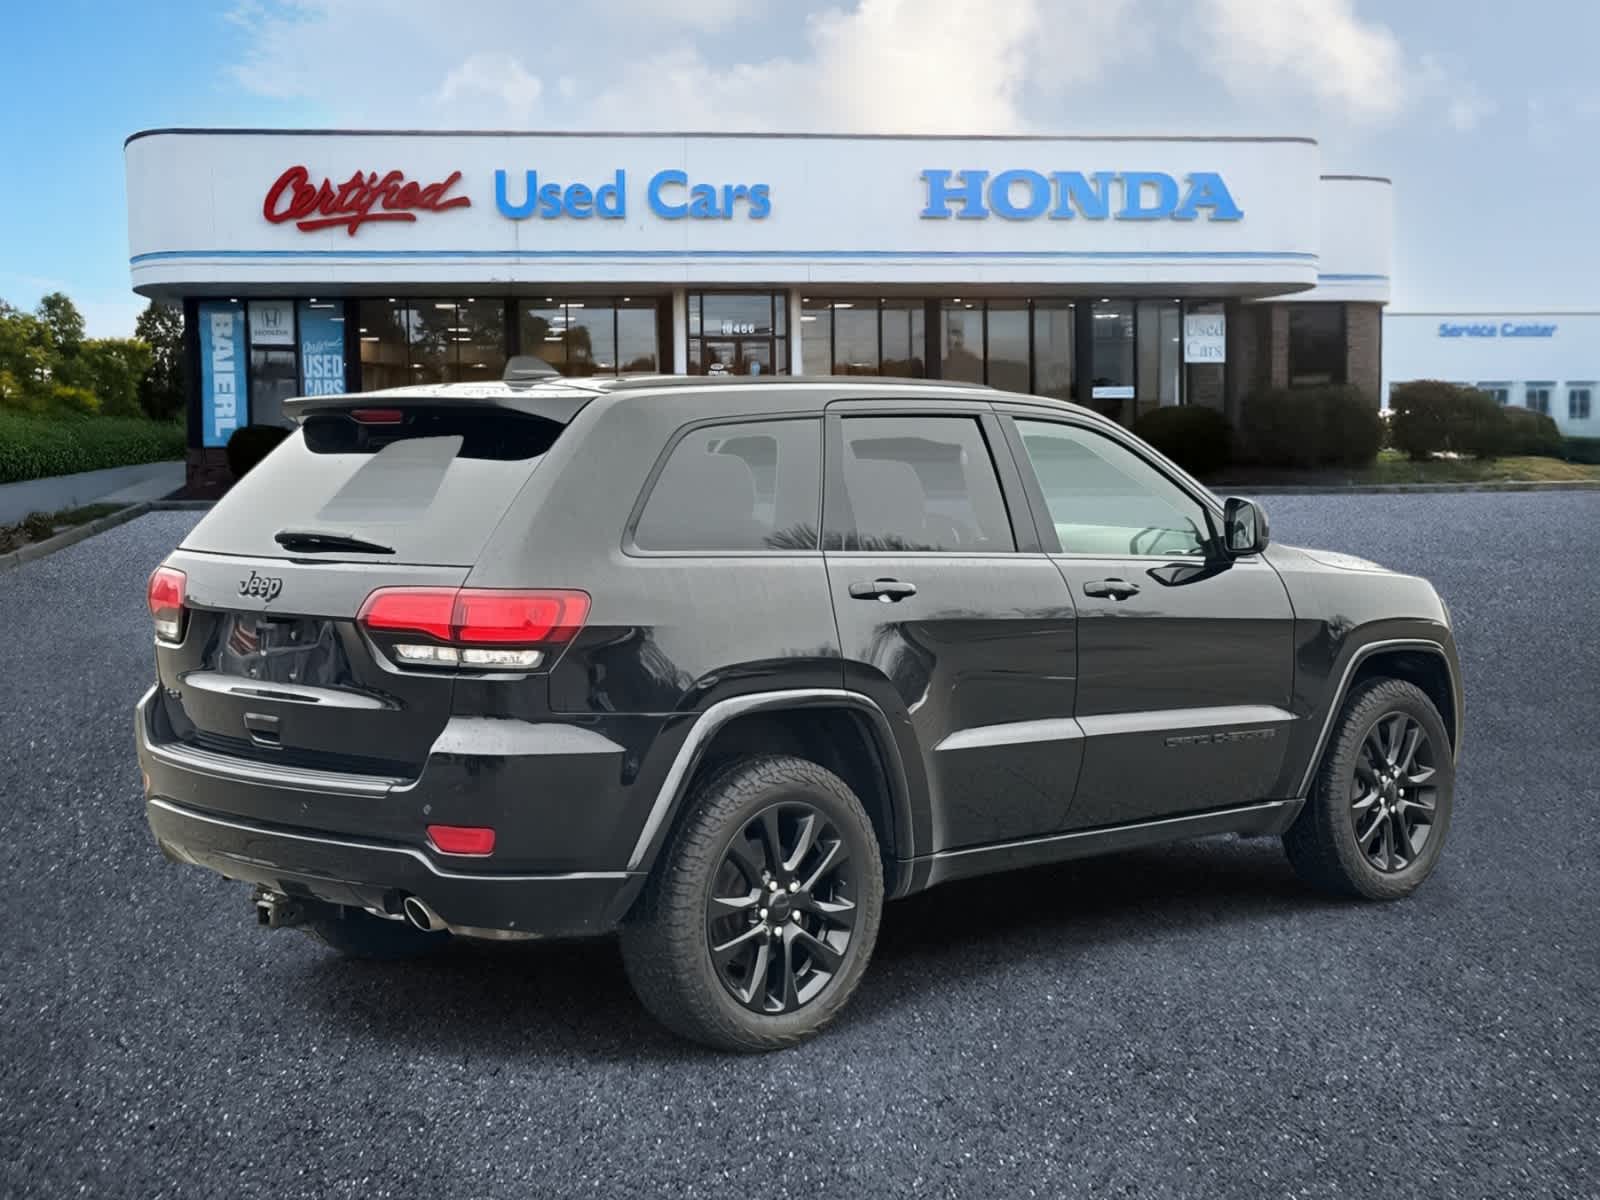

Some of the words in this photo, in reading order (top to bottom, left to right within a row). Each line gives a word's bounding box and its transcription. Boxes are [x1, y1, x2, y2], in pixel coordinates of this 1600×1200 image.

[264, 166, 471, 236] Certified
[495, 169, 626, 219] Used
[648, 169, 771, 219] Cars
[920, 169, 1244, 220] HONDA
[1186, 319, 1224, 337] Used
[303, 354, 343, 377] USED
[1187, 342, 1223, 358] Cars
[210, 312, 237, 438] BAIERL
[239, 570, 282, 602] Jeep
